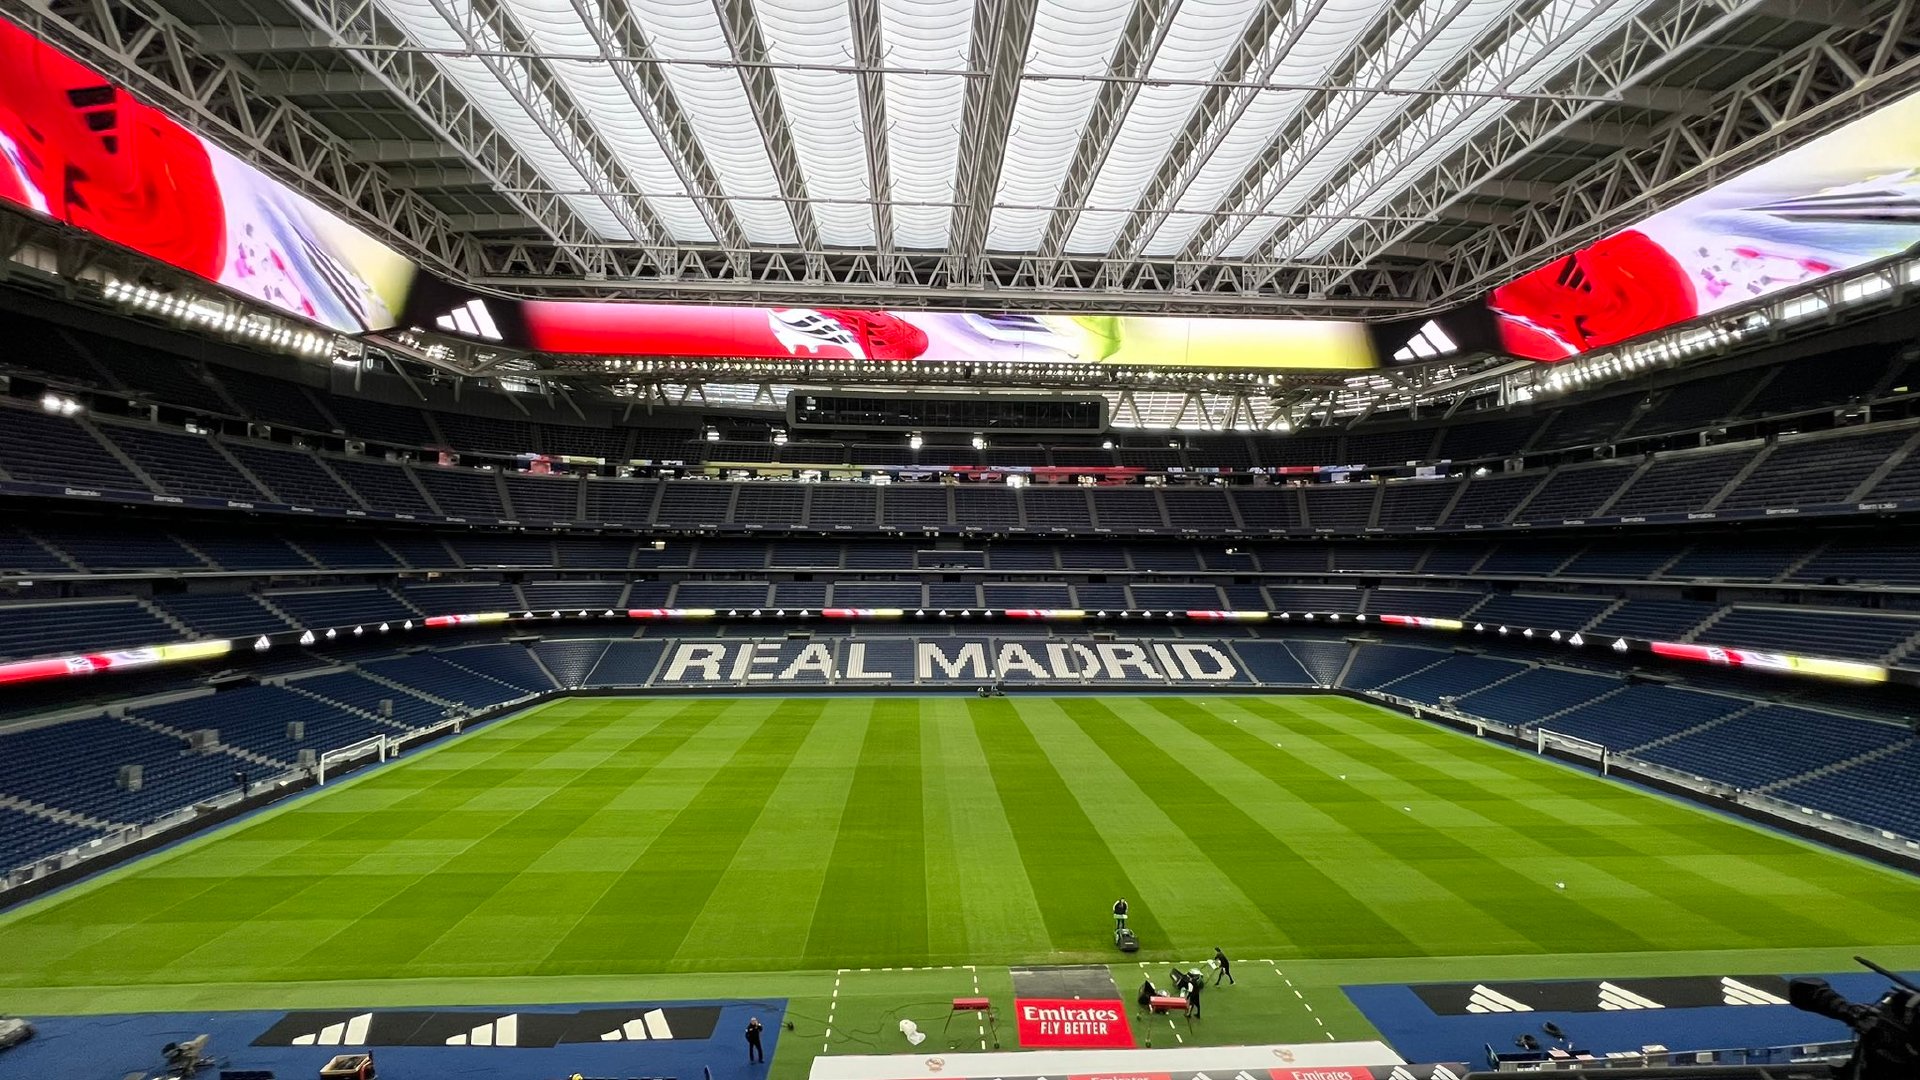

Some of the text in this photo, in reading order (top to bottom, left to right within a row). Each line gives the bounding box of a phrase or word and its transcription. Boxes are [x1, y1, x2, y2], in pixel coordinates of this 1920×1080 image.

[663, 643, 1237, 681] REAL MADRID
[1023, 1006, 1119, 1021] Emirates
[1041, 1021, 1108, 1035] FLY BETTER
[1290, 1070, 1353, 1080] Emirates
